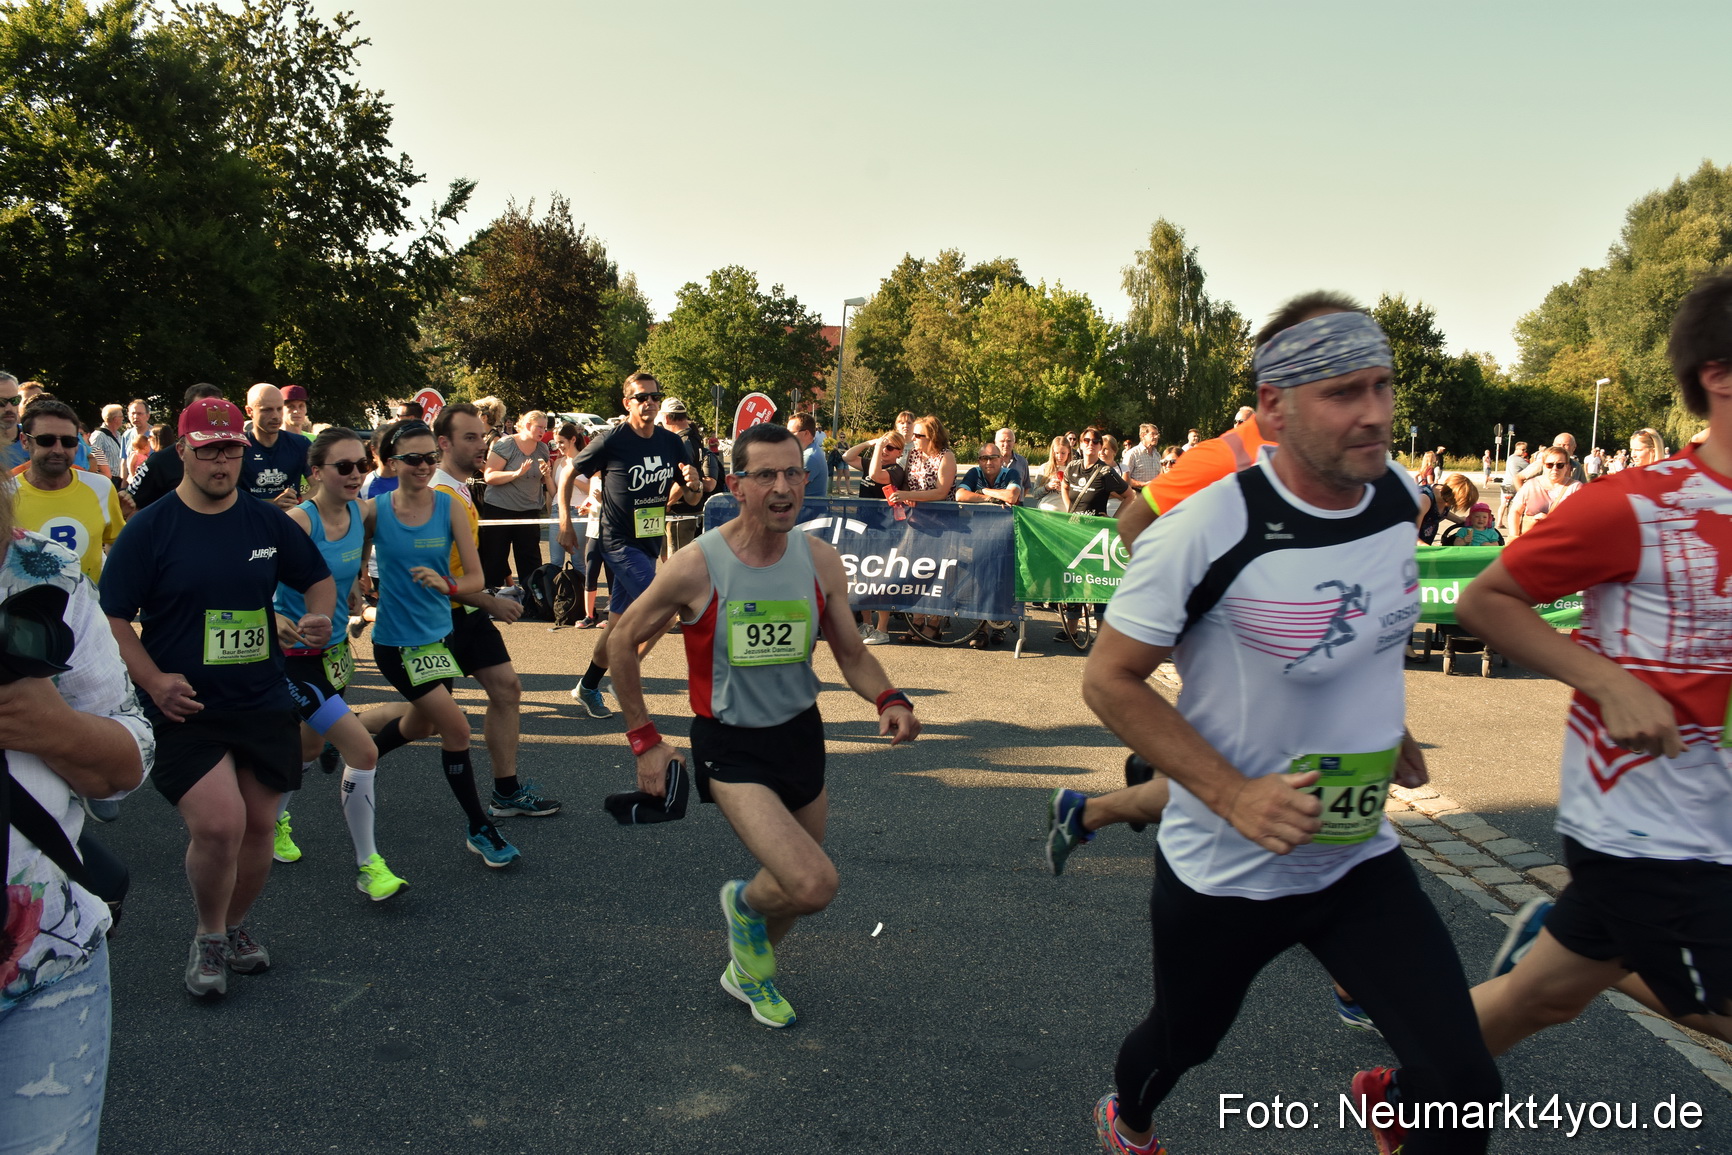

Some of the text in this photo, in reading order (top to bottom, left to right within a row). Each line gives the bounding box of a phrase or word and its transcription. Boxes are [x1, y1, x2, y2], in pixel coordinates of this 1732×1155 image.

[643, 518, 660, 529] 271
[50, 525, 77, 551] B
[833, 546, 958, 580] scher
[1064, 572, 1082, 584] Die
[1421, 581, 1459, 604] nd
[215, 628, 264, 649] 1138
[747, 623, 792, 647] 932
[412, 655, 451, 673] 2028
